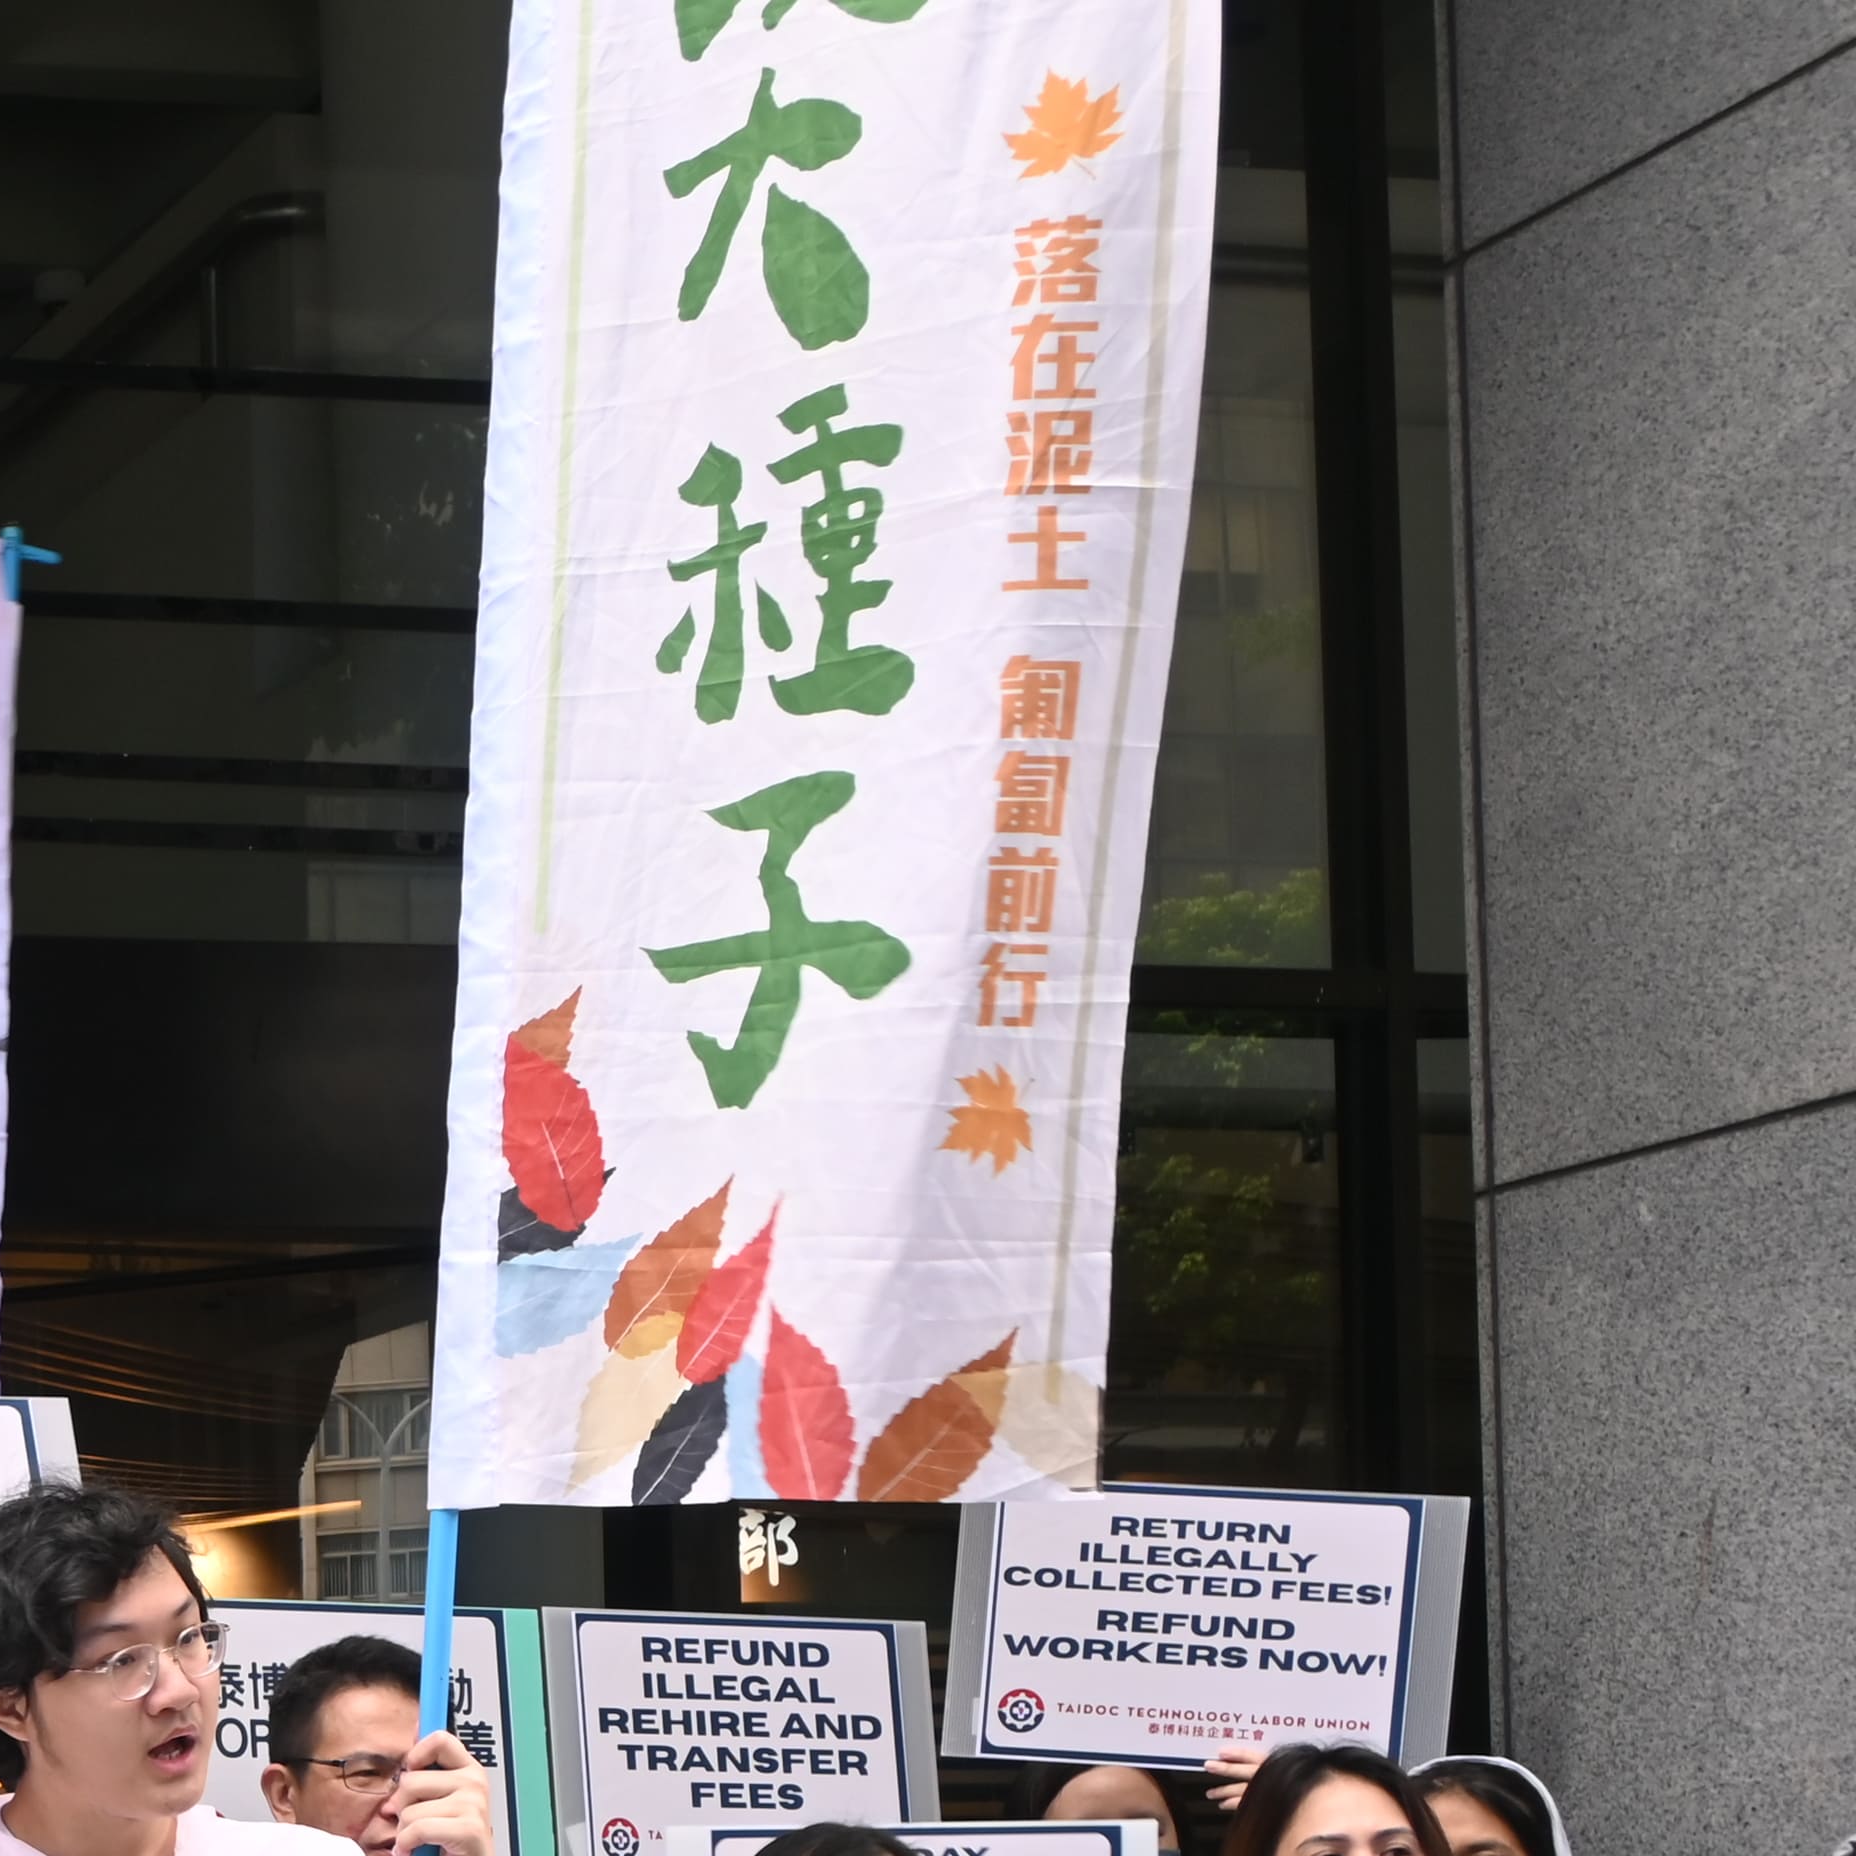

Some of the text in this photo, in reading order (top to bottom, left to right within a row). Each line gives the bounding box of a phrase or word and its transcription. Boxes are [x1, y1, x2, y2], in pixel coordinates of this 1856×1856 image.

[976, 213, 1105, 1028] 落在泥土 匍匐前行
[1109, 1515, 1291, 1545] RETURN
[1079, 1542, 1318, 1575] ILLEGALLY
[1002, 1566, 1393, 1606] COLLECTED FEES!
[1095, 1608, 1296, 1642] REFUND
[640, 1636, 830, 1669] REFUND
[1003, 1634, 1389, 1678] WORKERS NOW!
[641, 1672, 835, 1706] ILLEGAL
[597, 1708, 882, 1742] REHIRE AND
[1056, 1701, 1372, 1732] TAIDOC TECHNOLOGY LABOR UNION
[1147, 1721, 1265, 1741] 泰博科技企業工會
[617, 1744, 869, 1777] TRANSFER
[689, 1781, 804, 1811] FEES
